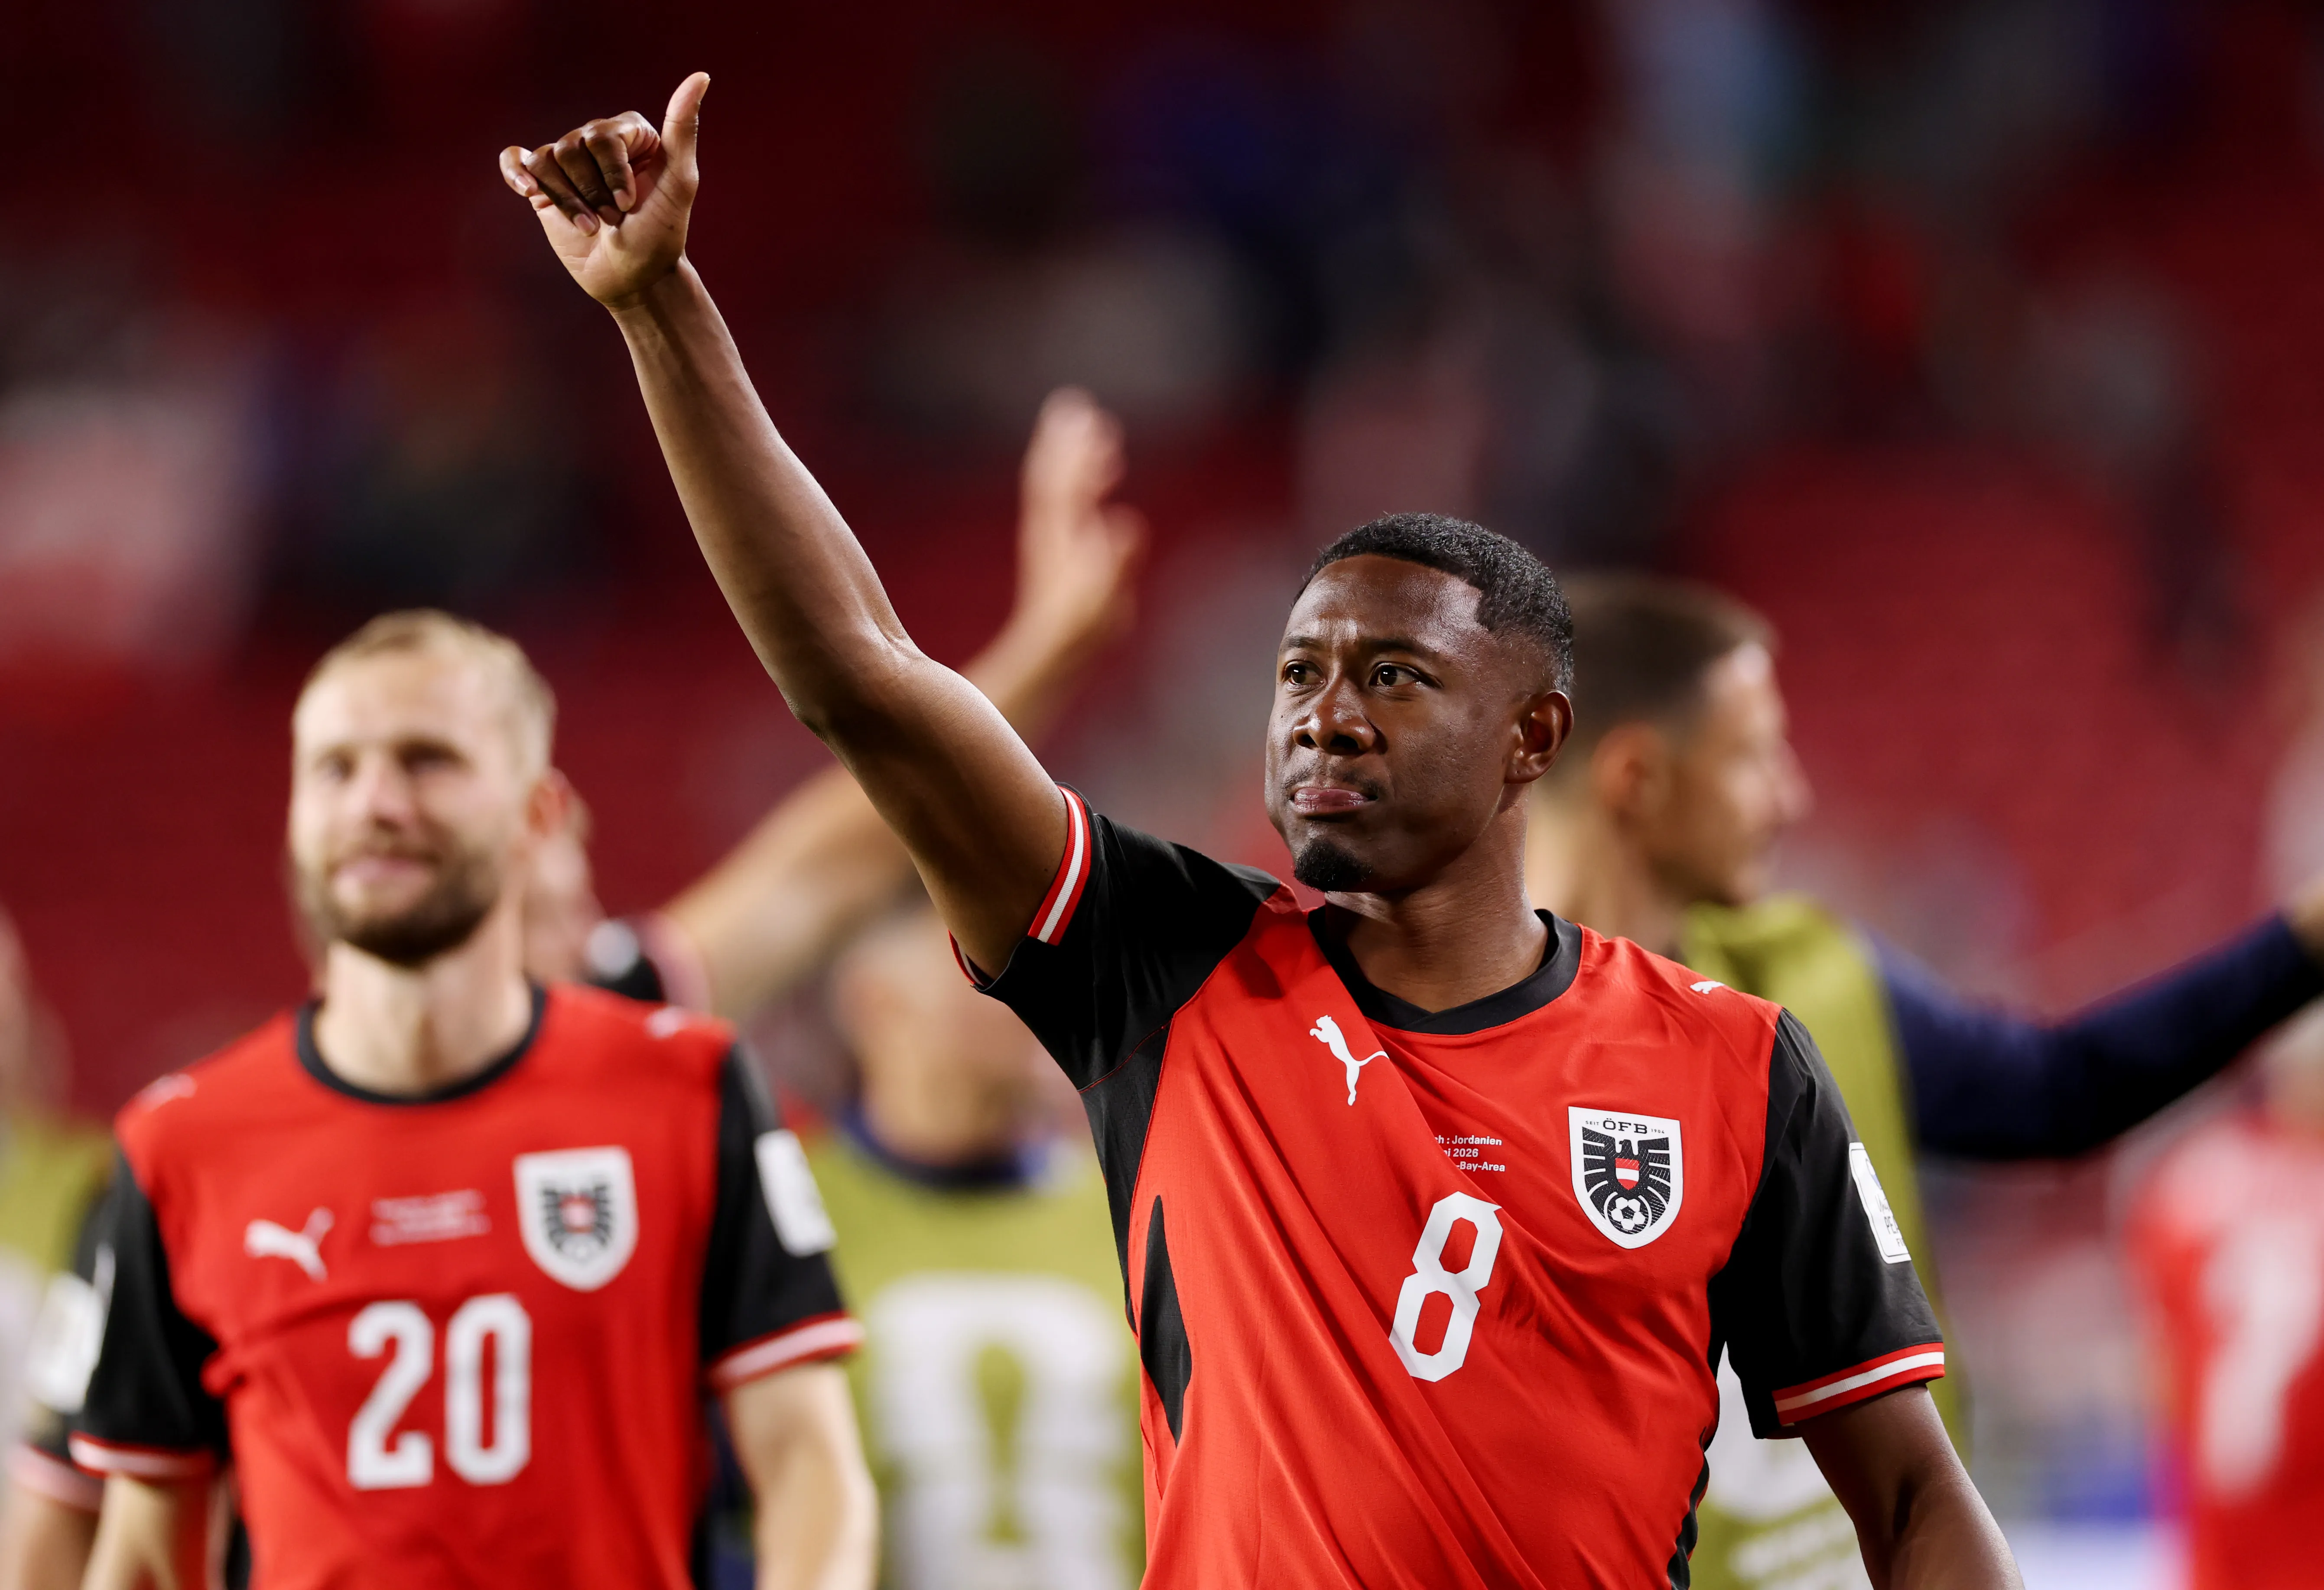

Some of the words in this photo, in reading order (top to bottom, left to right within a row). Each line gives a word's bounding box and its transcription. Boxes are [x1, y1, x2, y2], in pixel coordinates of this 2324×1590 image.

[1603, 1118, 1648, 1135] ÖFB
[1452, 1135, 1502, 1146] Jordanien
[1453, 1148, 1479, 1158] 2026
[1388, 1191, 1504, 1382] 8
[348, 1291, 532, 1491] 20
